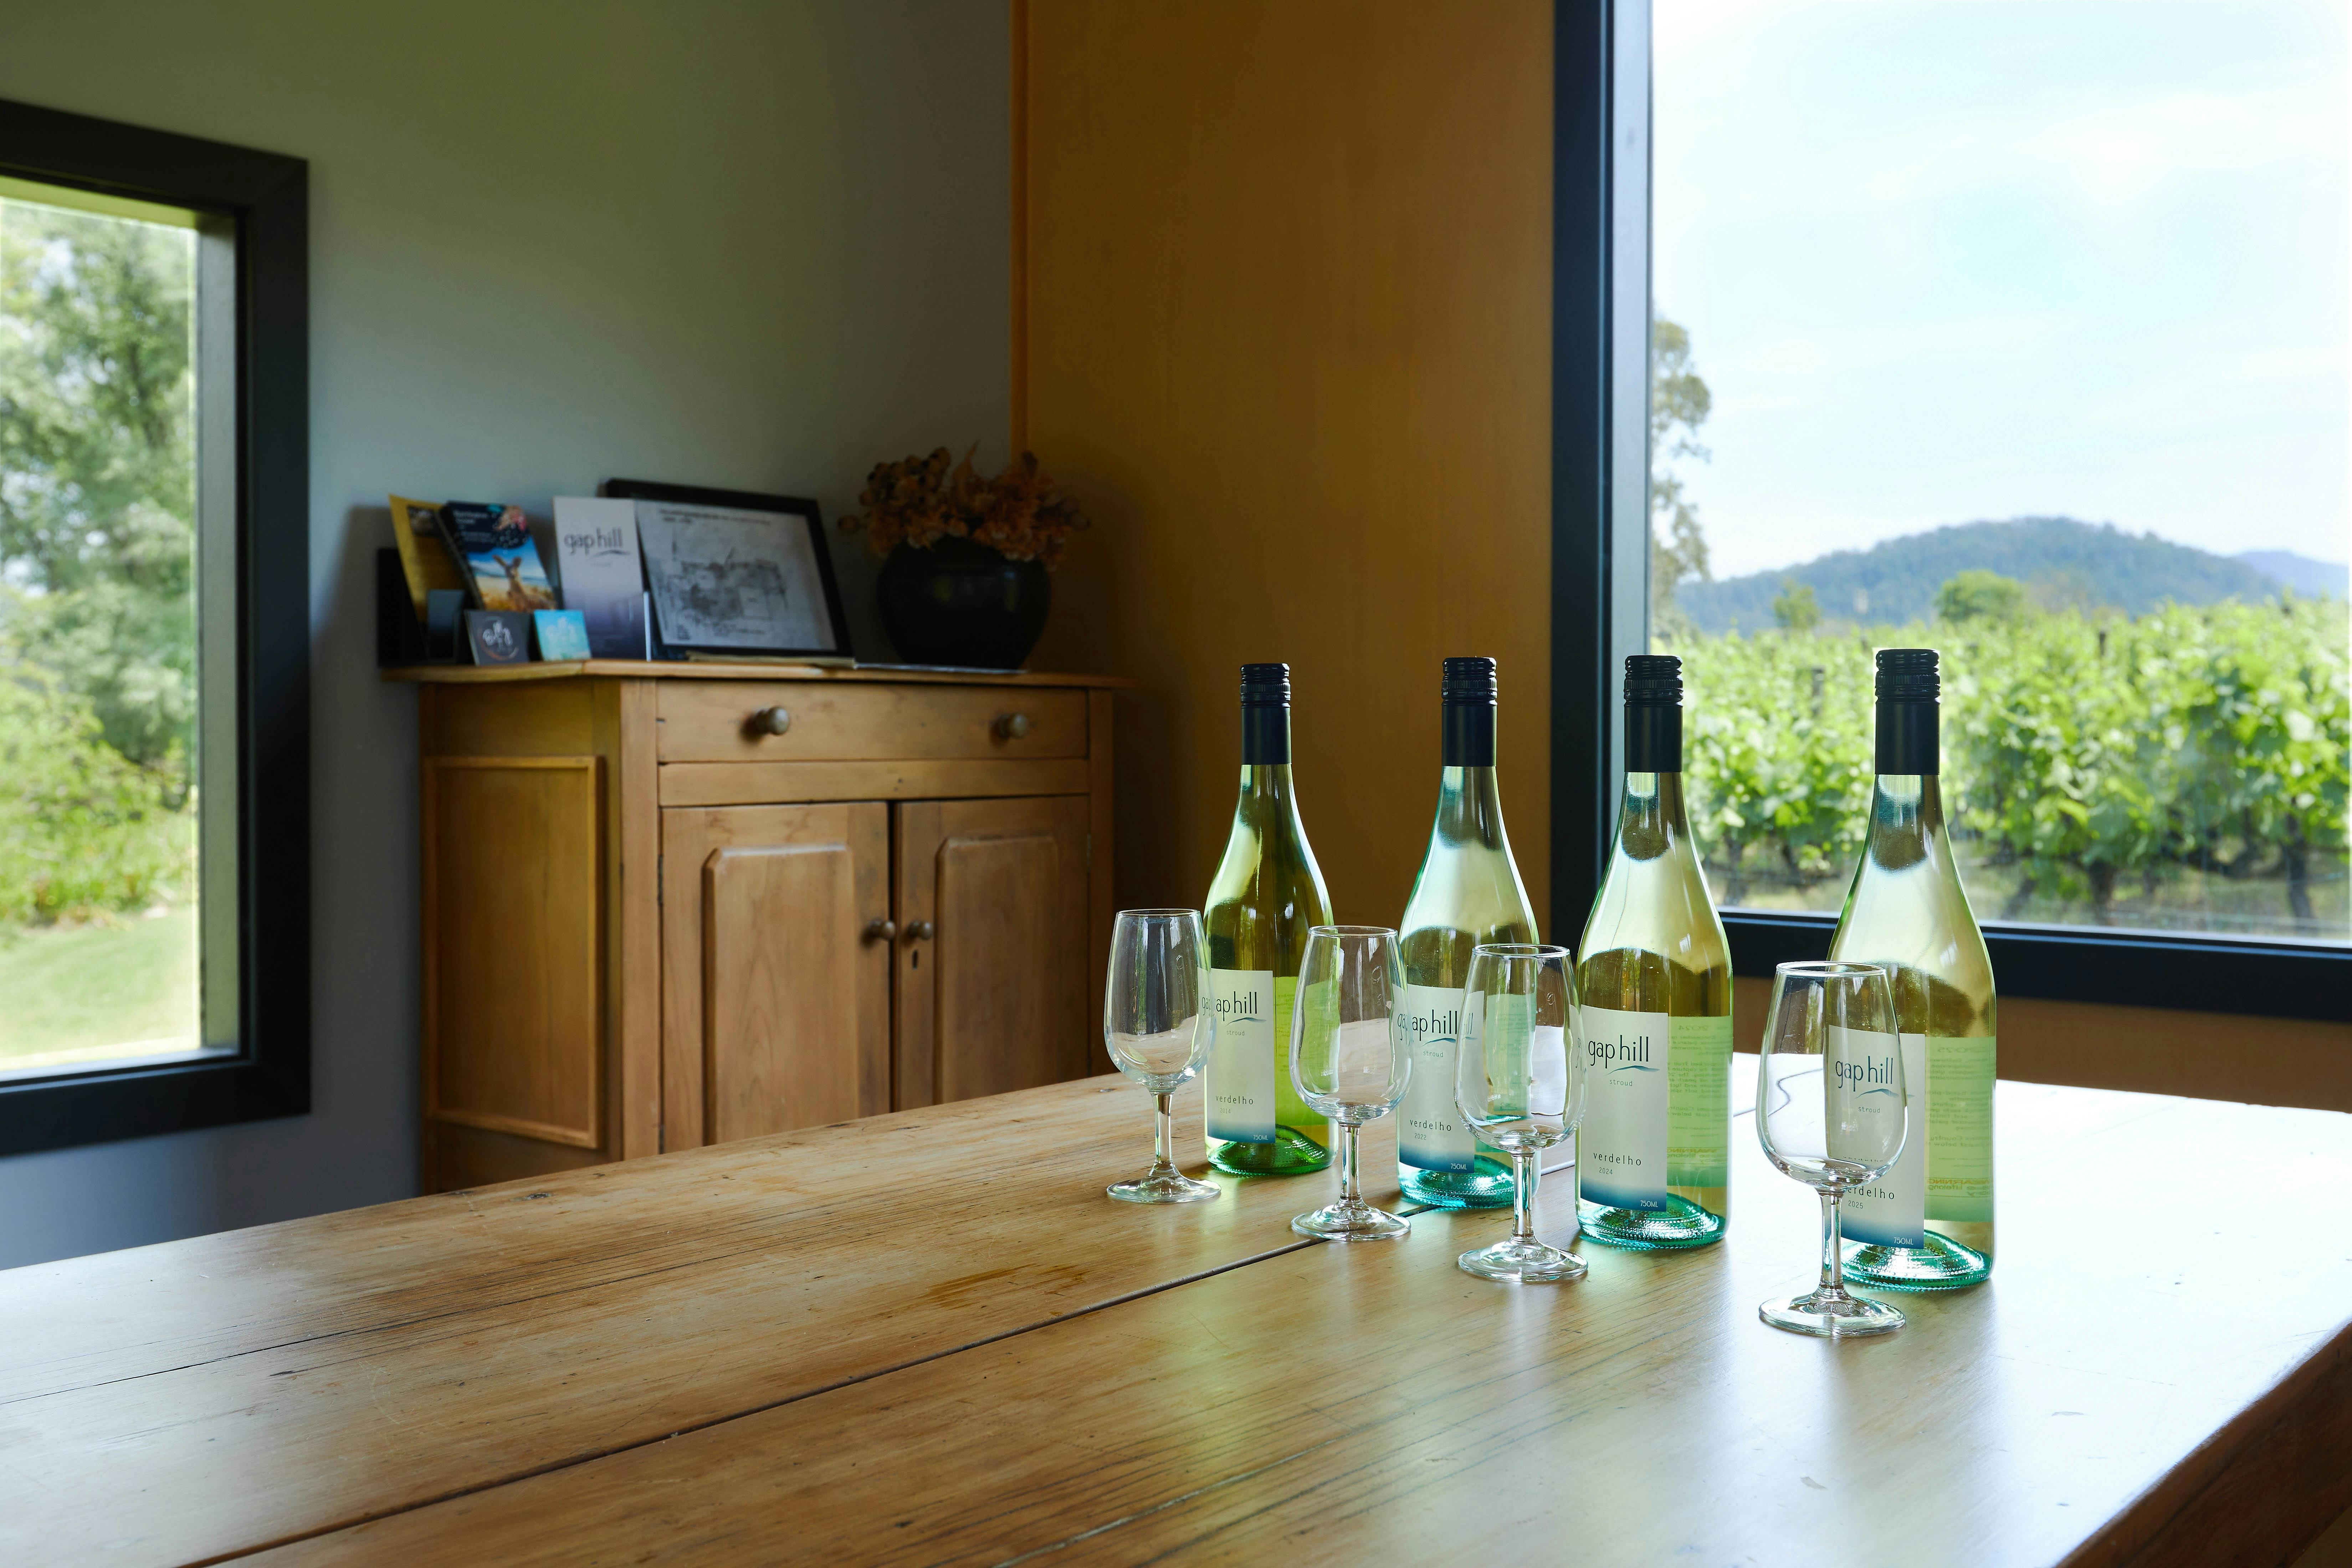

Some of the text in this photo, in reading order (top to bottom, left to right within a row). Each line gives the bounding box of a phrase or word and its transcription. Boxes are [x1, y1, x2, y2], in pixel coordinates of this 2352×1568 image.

[564, 526, 622, 556] gap hill
[1233, 991, 1257, 1014] hill
[1431, 1009, 1457, 1035] hill
[1588, 1035, 1649, 1069] gap hill
[1835, 1055, 1893, 1092] gap hill
[1216, 1095, 1253, 1105] verdelho
[1410, 1119, 1451, 1131] verdelho
[1594, 1153, 1641, 1166] verdelho
[1848, 1186, 1894, 1199] erdelho
[1848, 1200, 1863, 1209] 2025
